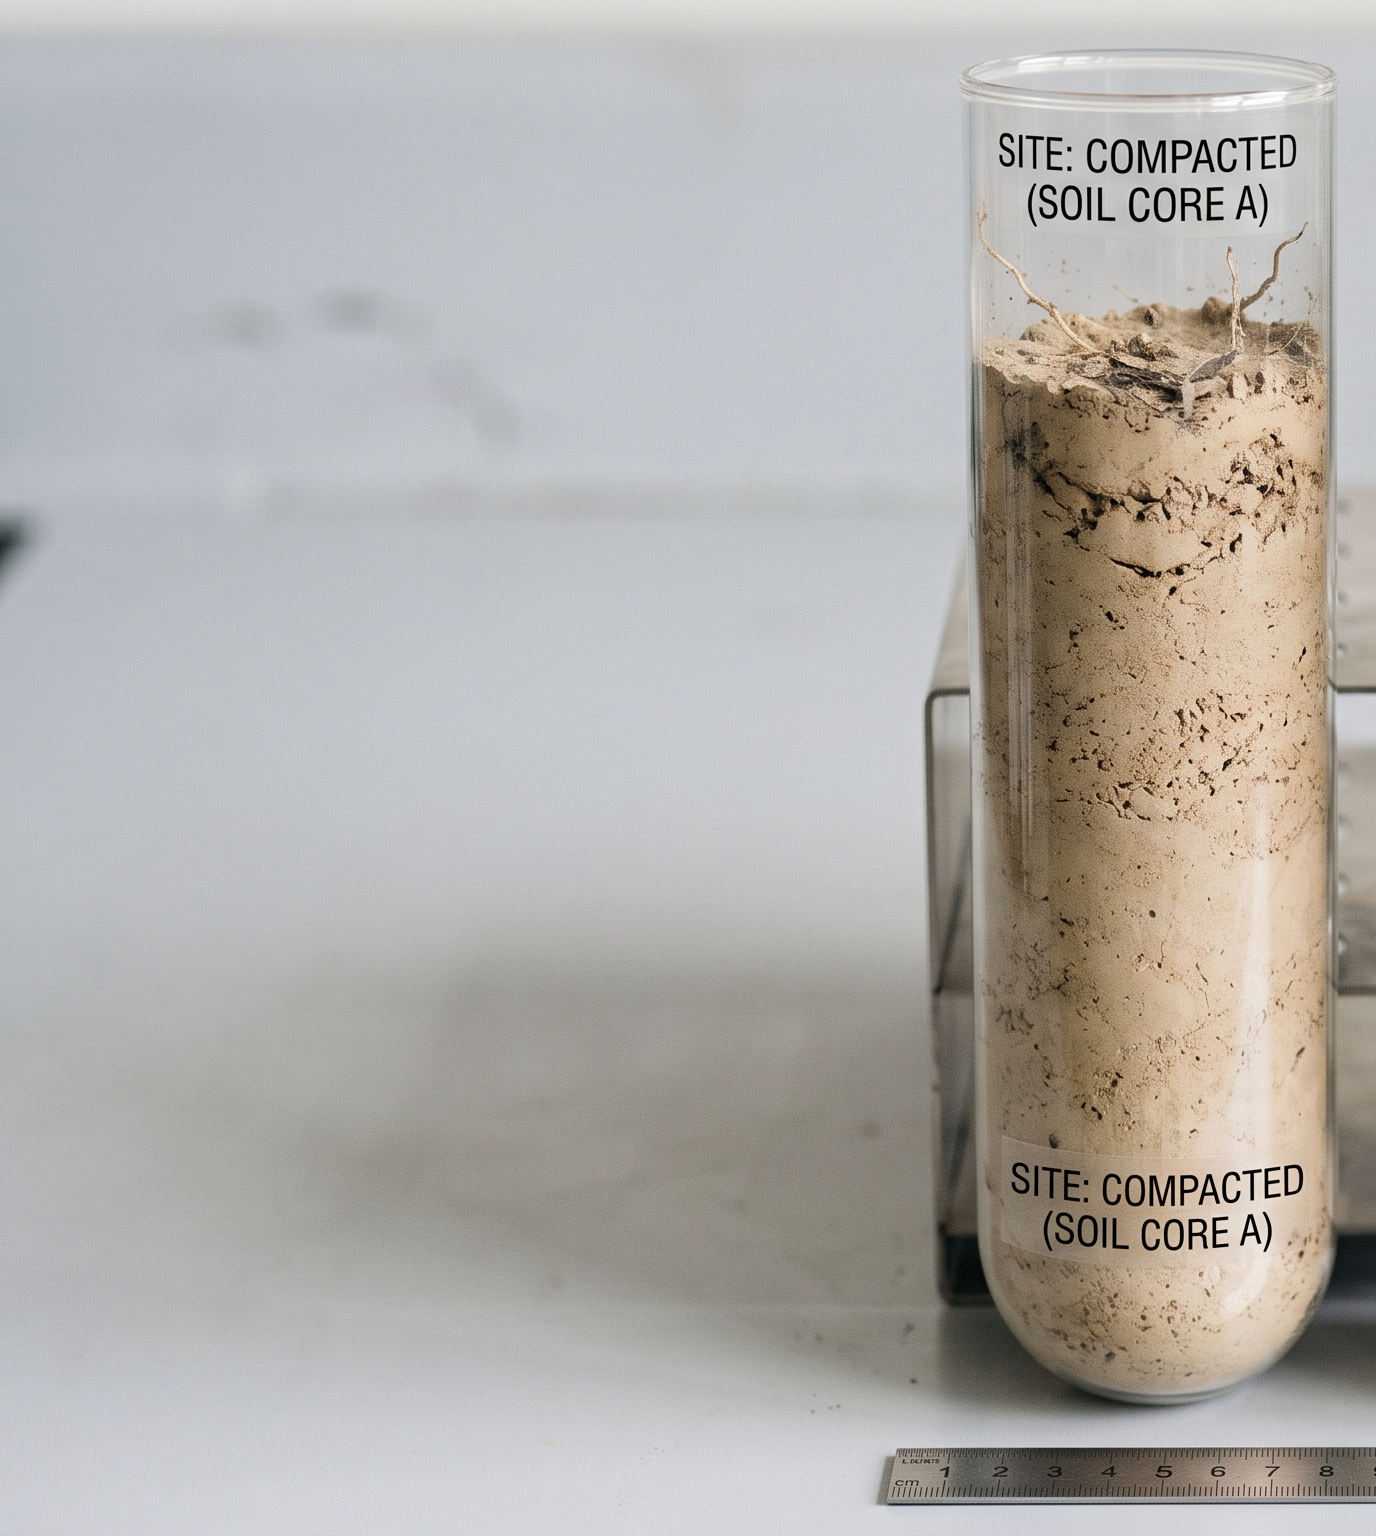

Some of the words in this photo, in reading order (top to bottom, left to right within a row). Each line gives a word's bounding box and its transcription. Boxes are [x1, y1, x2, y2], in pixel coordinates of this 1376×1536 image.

[999, 132, 1073, 171] SITE:
[1086, 134, 1298, 174] COMPACTED
[1027, 183, 1116, 227] (SOIL
[1128, 186, 1224, 223] CORE
[1235, 183, 1268, 228] A)
[1011, 1162, 1090, 1203] SITE:
[1102, 1163, 1304, 1207] COMPACTED
[1043, 1210, 1130, 1252] (SOIL
[1141, 1216, 1229, 1251] CORE
[1239, 1211, 1272, 1253] A)
[895, 1479, 919, 1487] cm
[939, 1466, 950, 1478] 1
[992, 1466, 1009, 1478] 2
[1047, 1466, 1063, 1478] 3
[1101, 1466, 1117, 1478] 4
[1155, 1465, 1173, 1478] 5
[1210, 1466, 1226, 1477] 6
[1265, 1466, 1280, 1478] 7
[1319, 1465, 1334, 1477] 8
